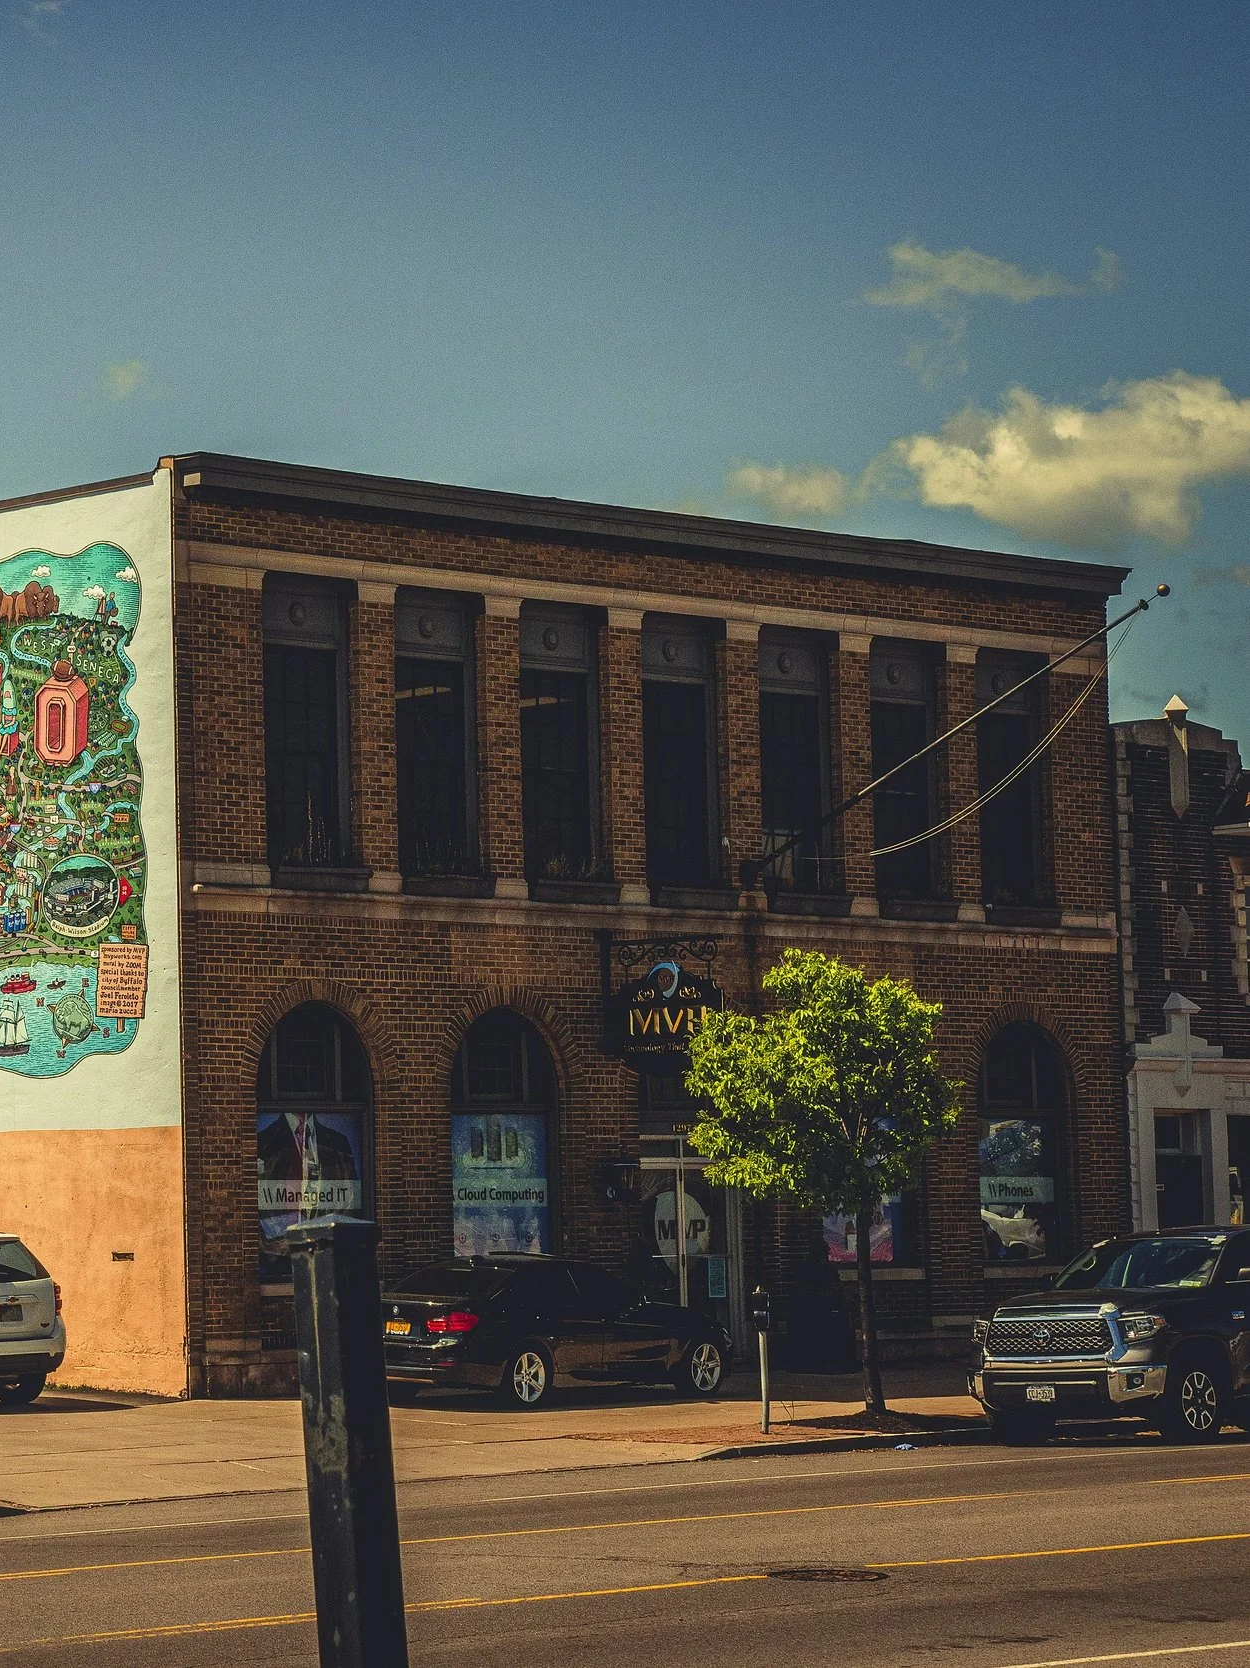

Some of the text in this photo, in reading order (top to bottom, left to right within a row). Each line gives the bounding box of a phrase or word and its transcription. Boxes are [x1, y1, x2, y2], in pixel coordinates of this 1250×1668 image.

[23, 638, 56, 653] WEST
[76, 654, 119, 684] SENECA
[101, 946, 125, 954] sponsored
[133, 947, 146, 955] MVP
[101, 968, 119, 976] special
[102, 977, 143, 985] city of Buffalo
[100, 991, 139, 1000] Joel Feroleto
[276, 1187, 333, 1207] Managed
[335, 1187, 347, 1203] IT
[458, 1186, 544, 1206] Cloud Computing
[998, 1183, 1034, 1198] Phones
